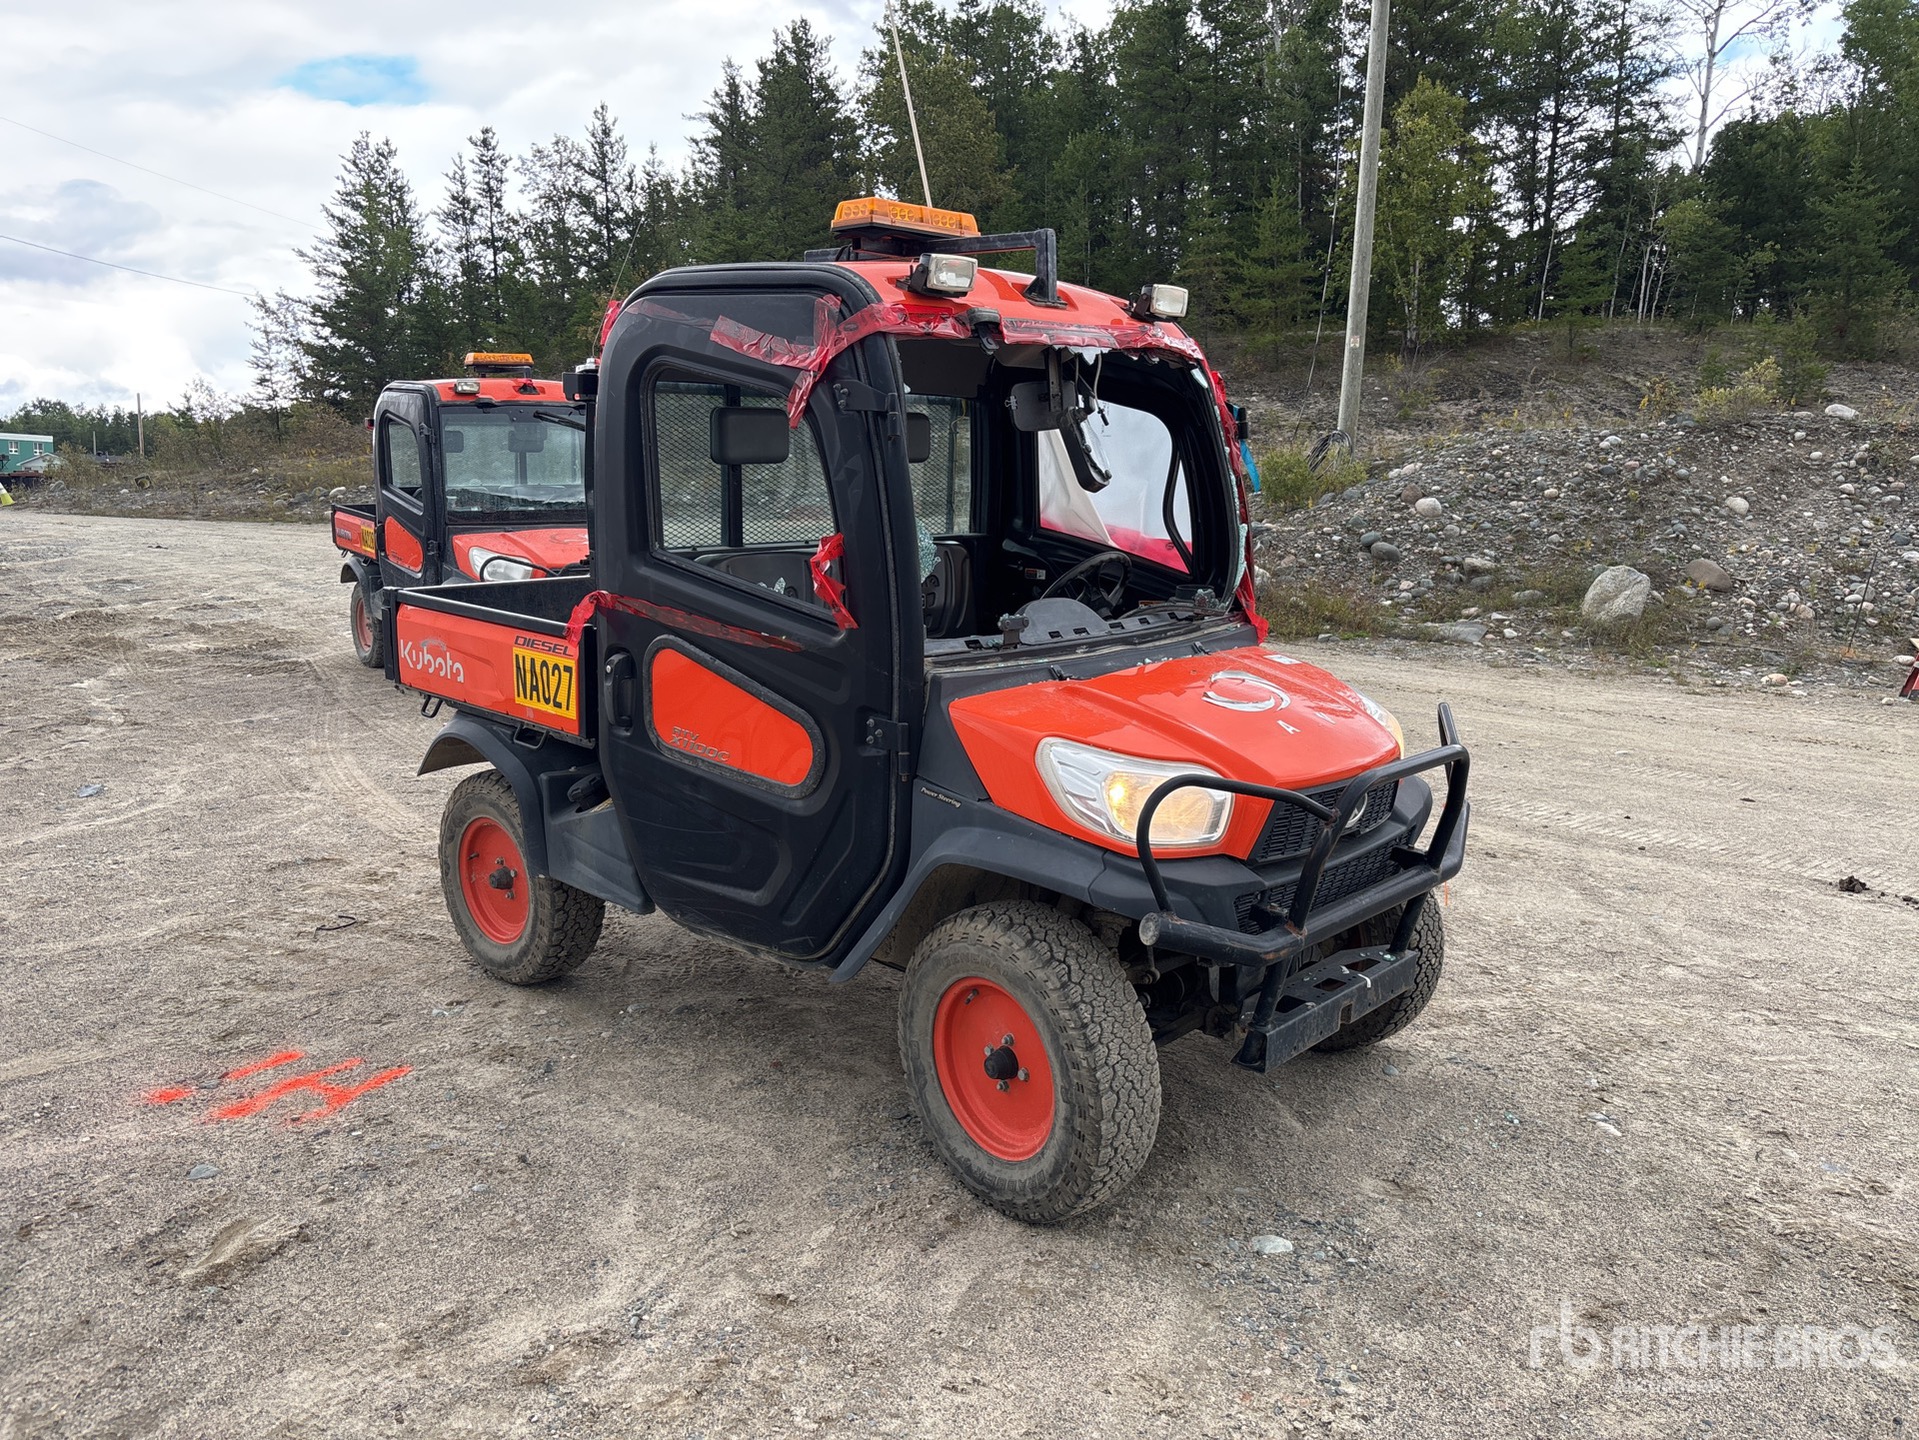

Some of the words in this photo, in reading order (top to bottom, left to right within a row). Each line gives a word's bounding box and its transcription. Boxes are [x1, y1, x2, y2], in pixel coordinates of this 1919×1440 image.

[400, 639, 464, 683] Kubota
[514, 635, 574, 657] DIESEL
[515, 654, 574, 711] NA027
[920, 786, 938, 798] Power
[937, 793, 962, 809] Steering
